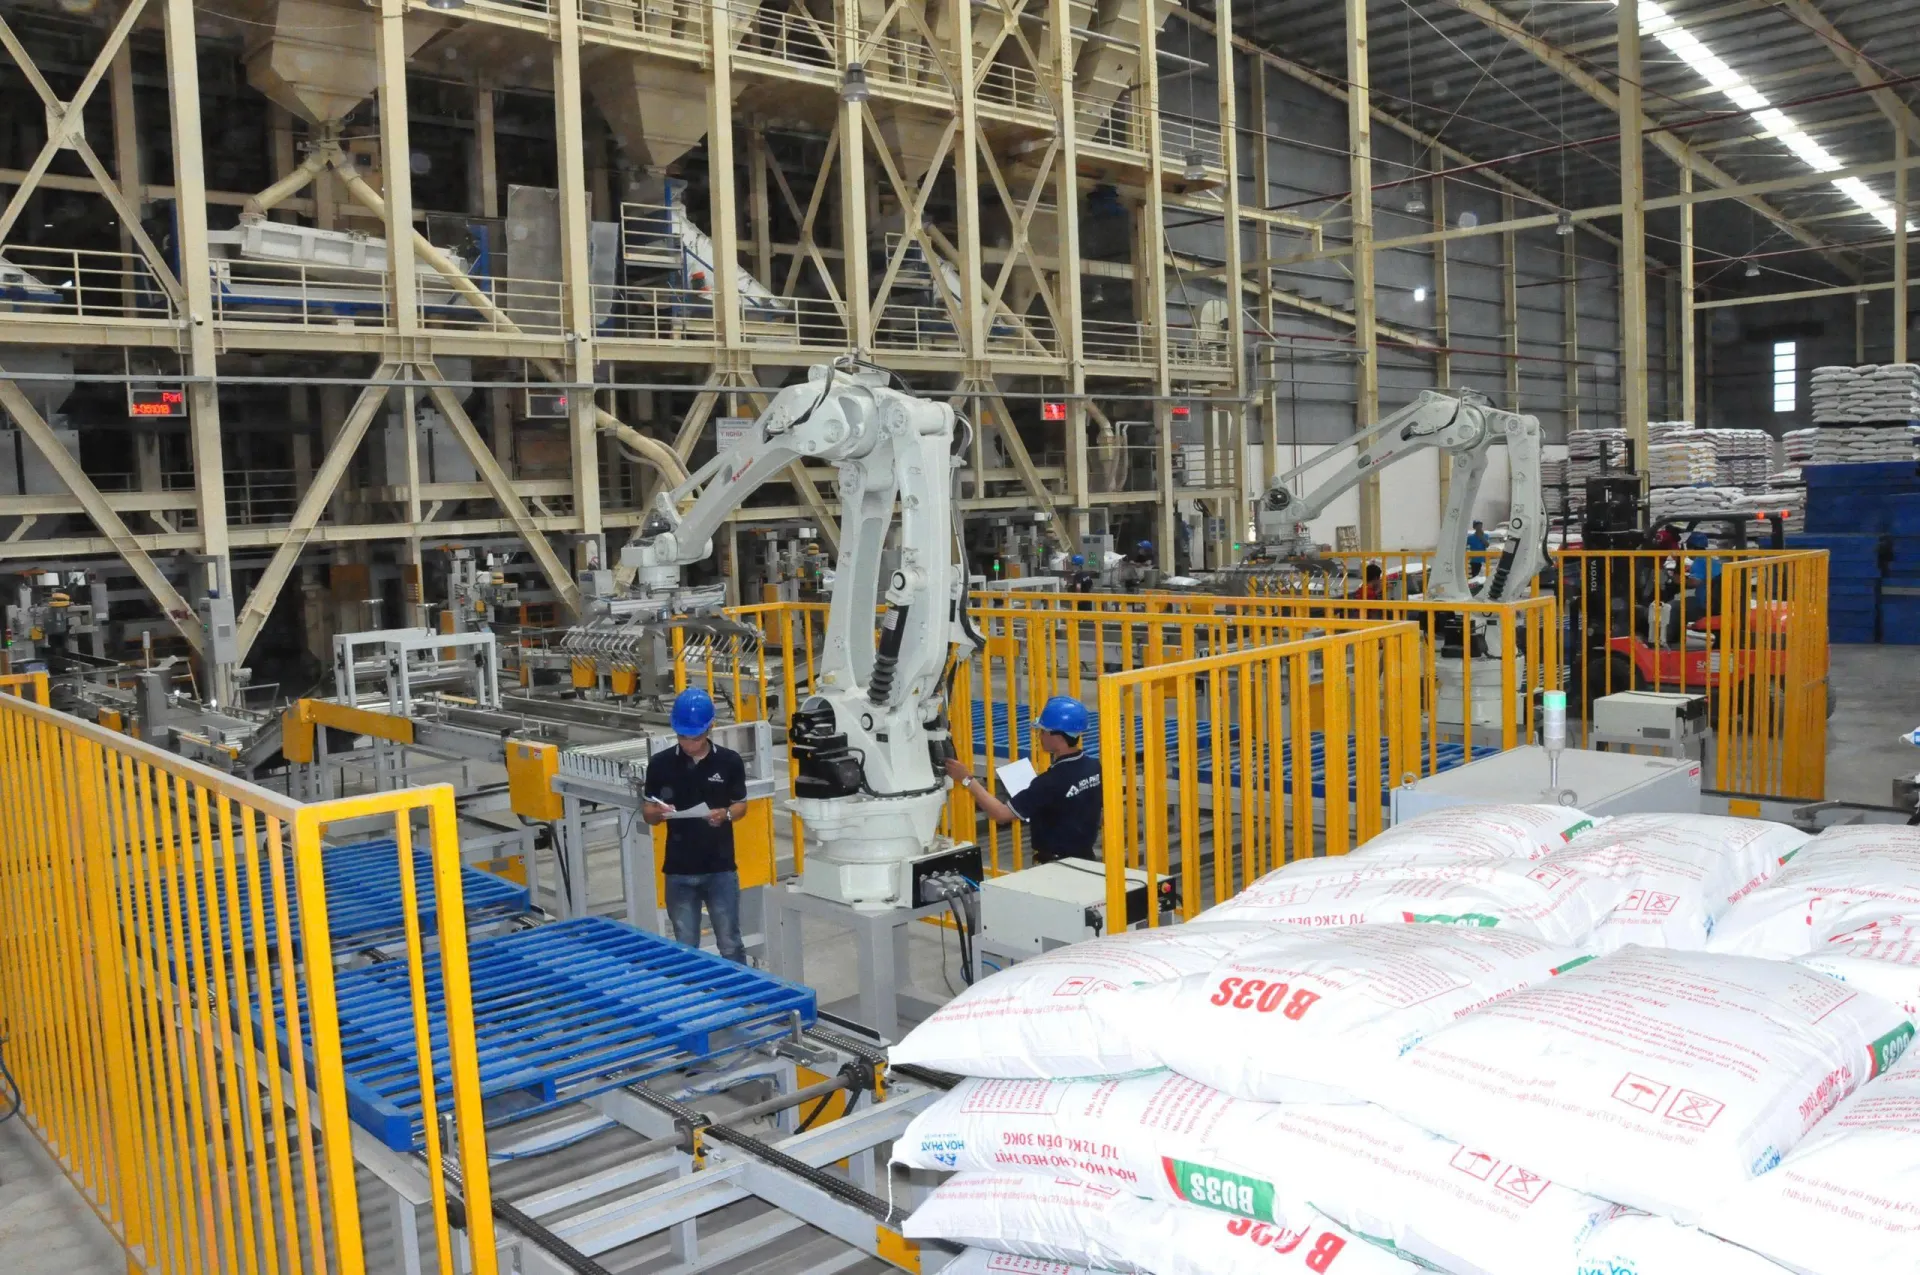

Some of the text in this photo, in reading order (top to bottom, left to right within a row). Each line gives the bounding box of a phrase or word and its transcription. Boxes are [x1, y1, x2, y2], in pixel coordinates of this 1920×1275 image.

[1002, 1132, 1034, 1146] 30KG
[994, 1149, 1021, 1165] THỊT
[1022, 1154, 1048, 1166] HEO
